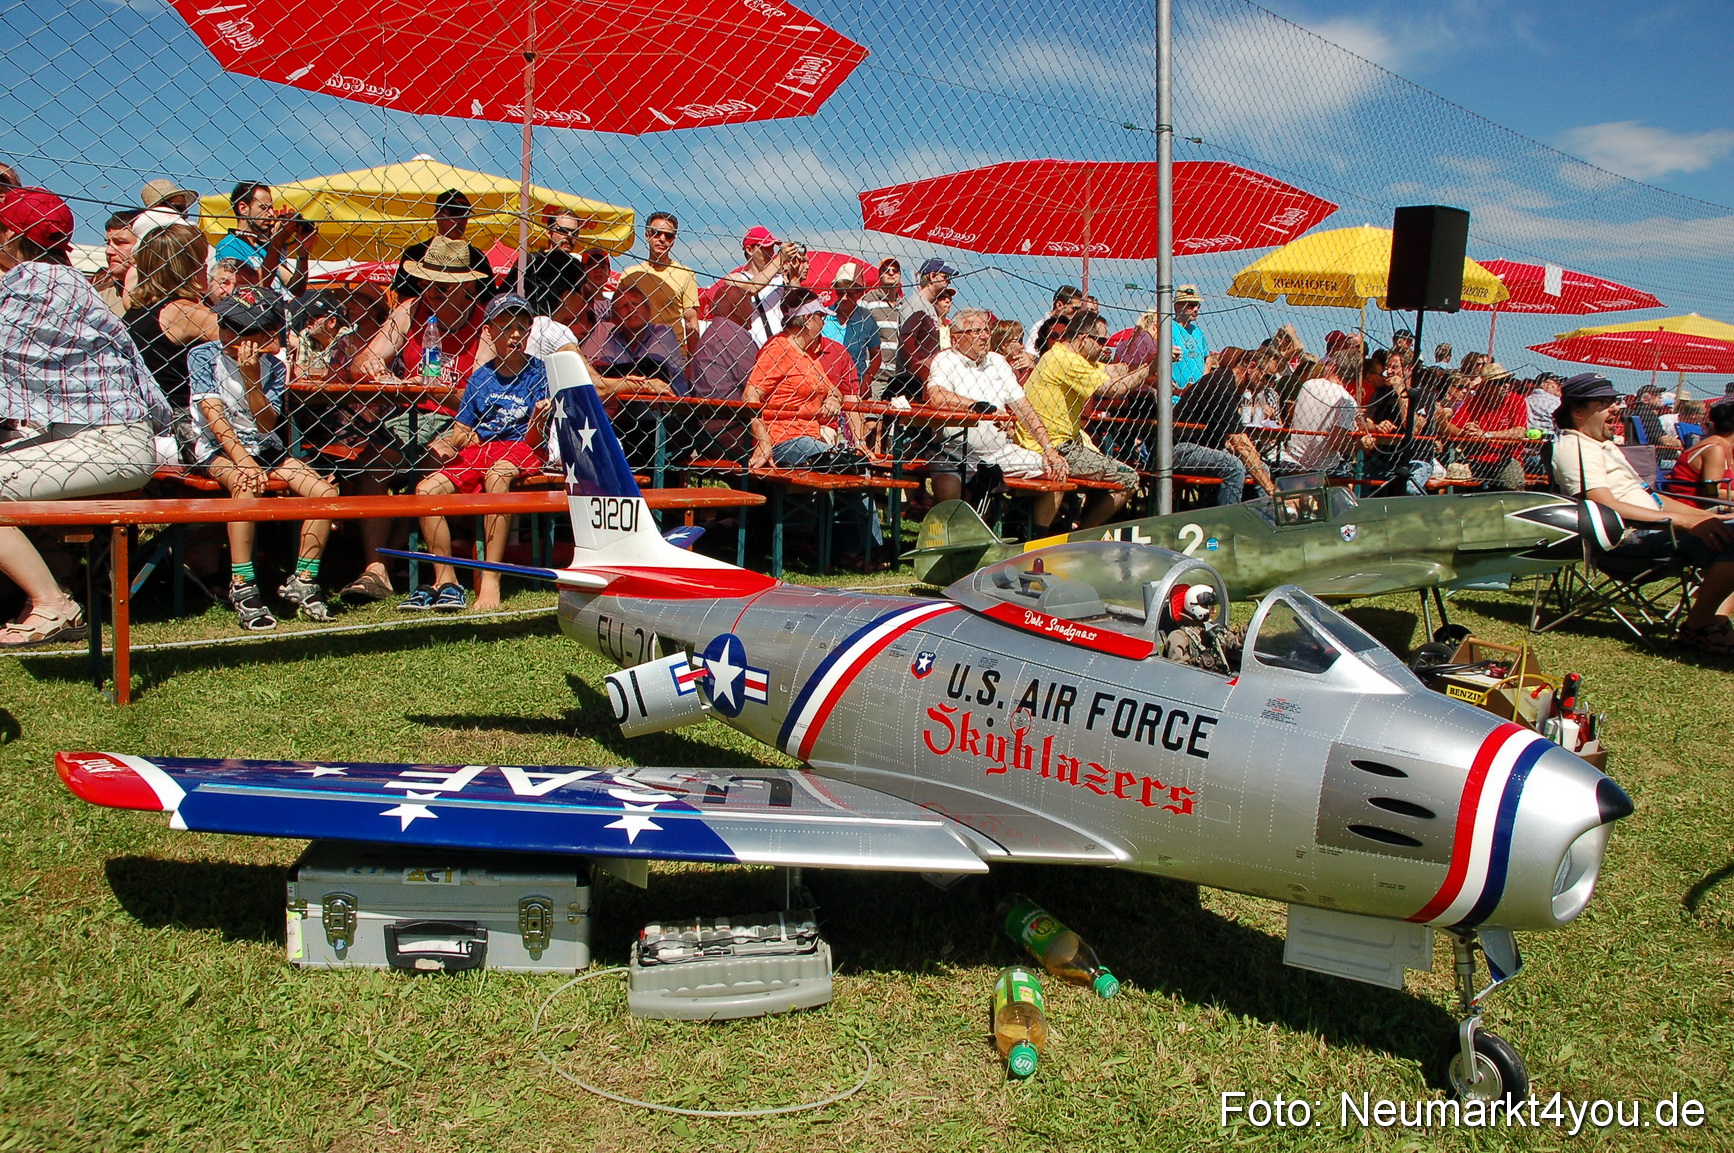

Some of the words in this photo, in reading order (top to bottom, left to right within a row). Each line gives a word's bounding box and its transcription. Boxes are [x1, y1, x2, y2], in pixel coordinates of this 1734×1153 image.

[1273, 278, 1338, 292] RIEMHOFER
[590, 496, 640, 532] 31201
[946, 662, 1004, 710] U.S.
[1016, 678, 1078, 726] AIR
[1085, 690, 1219, 760] FORCE
[922, 701, 1199, 816] Skyblazers
